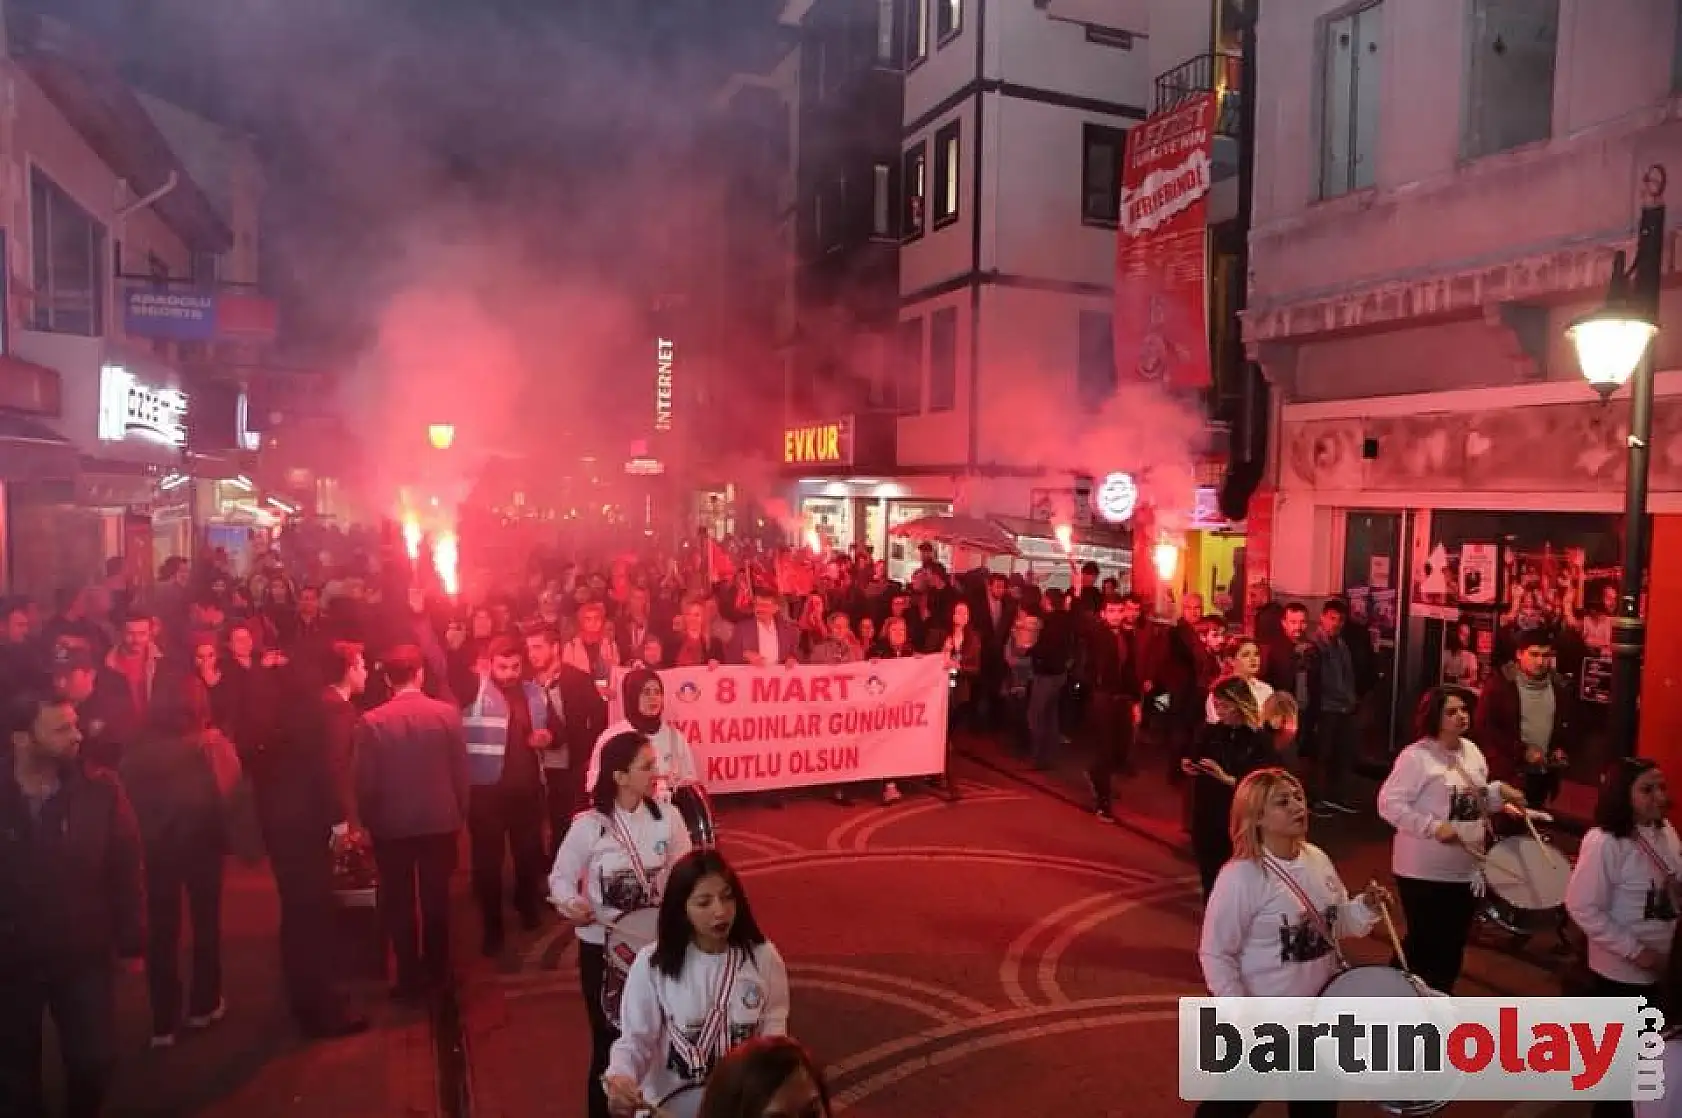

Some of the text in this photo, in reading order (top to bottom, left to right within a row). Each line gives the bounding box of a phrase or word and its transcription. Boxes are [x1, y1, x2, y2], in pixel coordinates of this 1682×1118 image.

[715, 674, 856, 704] 8 MART
[709, 712, 822, 744] KADINLAR
[829, 703, 928, 735] GÜNÜNÜZ
[707, 746, 860, 781] KUTLU OLSUN
